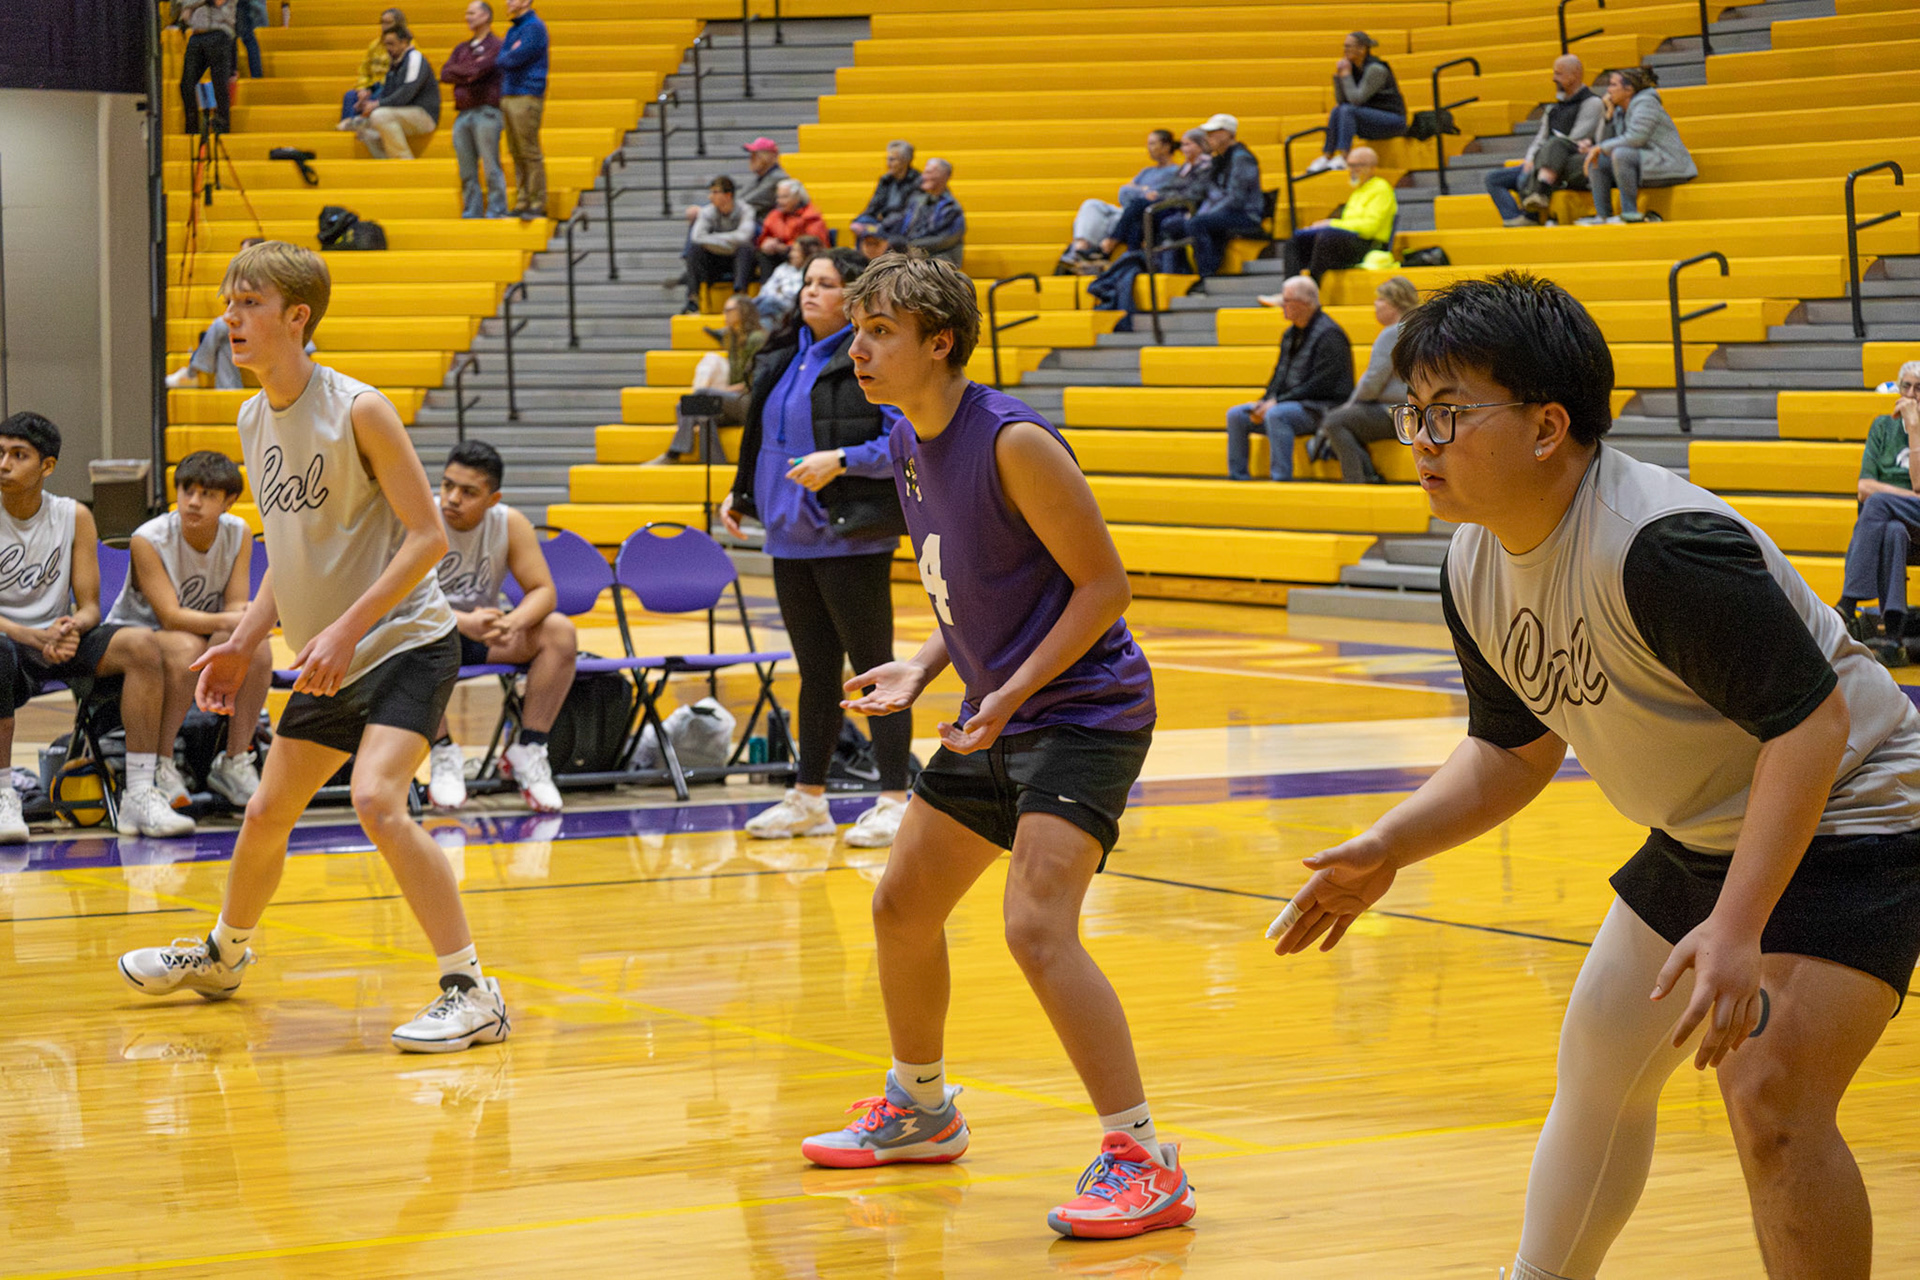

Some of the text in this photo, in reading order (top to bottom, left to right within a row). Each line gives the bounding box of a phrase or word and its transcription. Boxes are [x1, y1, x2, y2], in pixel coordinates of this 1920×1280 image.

[259, 444, 329, 518] Cal
[0, 542, 61, 592] Cal
[918, 532, 955, 627] 4
[1501, 607, 1609, 716] Cal
